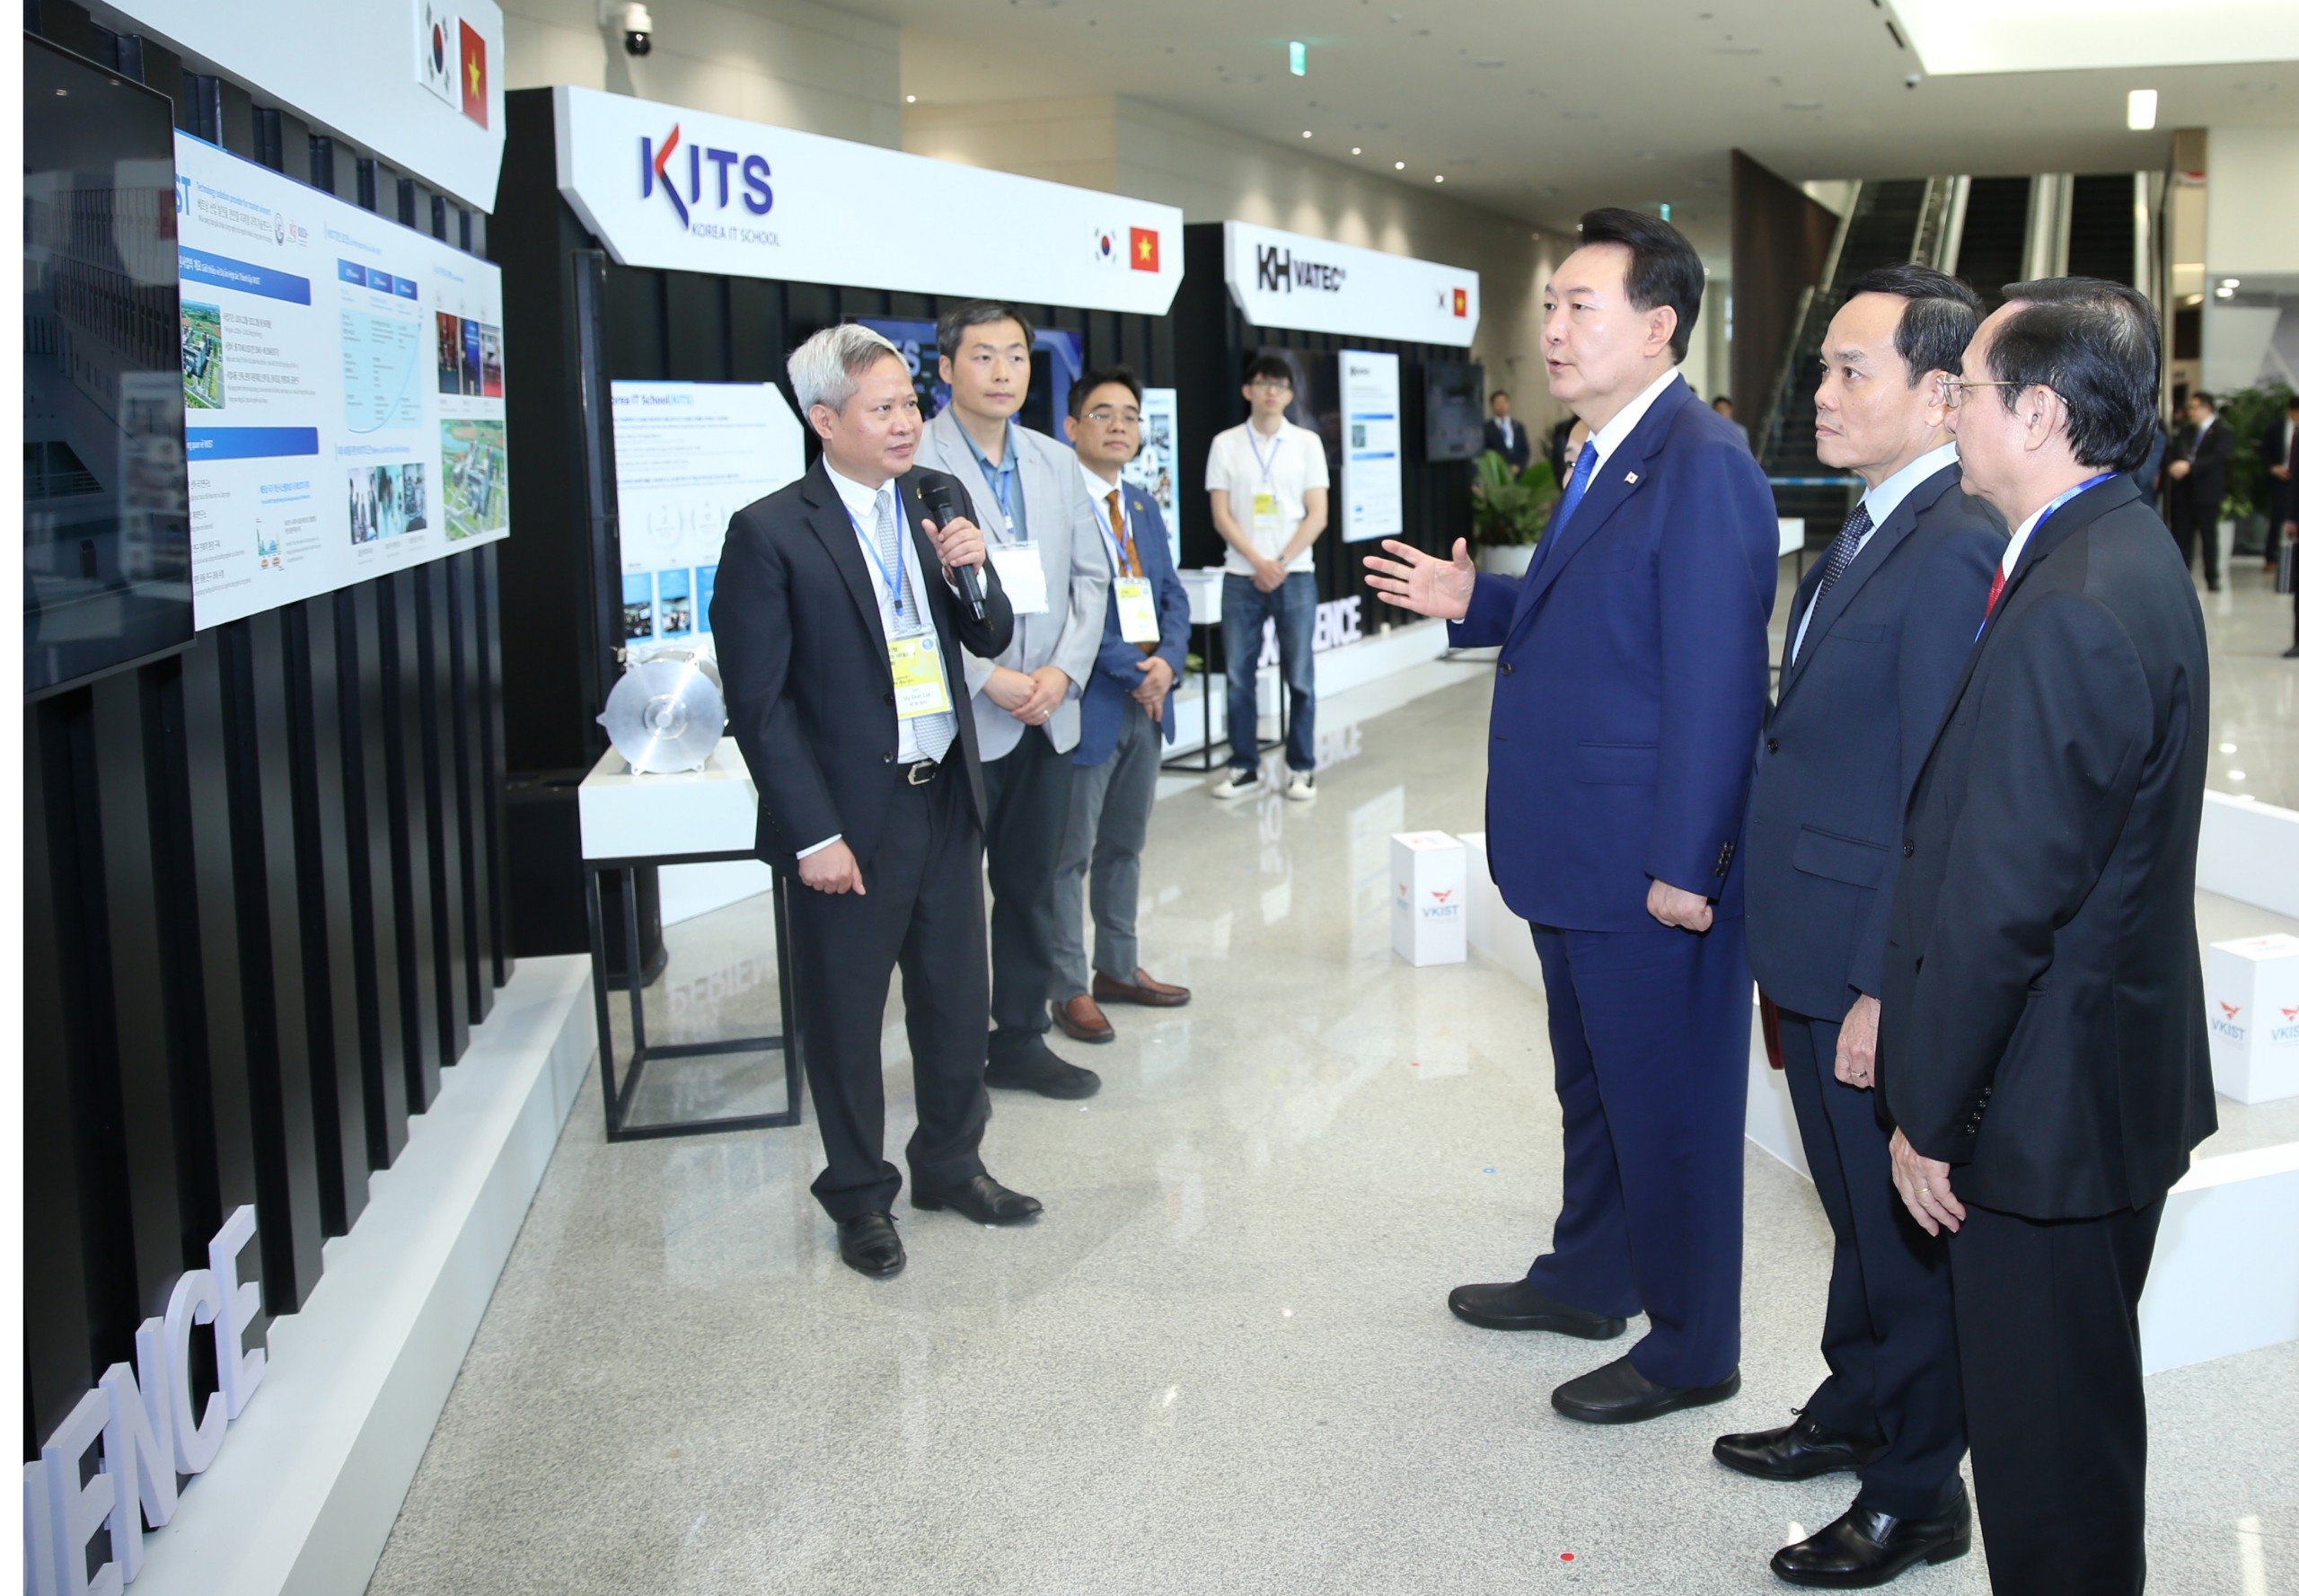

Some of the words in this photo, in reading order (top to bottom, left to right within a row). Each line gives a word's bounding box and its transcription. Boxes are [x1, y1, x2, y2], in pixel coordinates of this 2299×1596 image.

[641, 122, 773, 231] KITS
[691, 224, 727, 240] KOREA
[729, 227, 737, 242] IT
[741, 229, 780, 246] SCHOOL
[1257, 243, 1290, 293] KH
[1293, 260, 1343, 292] VATEC
[1422, 905, 1458, 917] VKIST
[2212, 1018, 2245, 1040] VKIST
